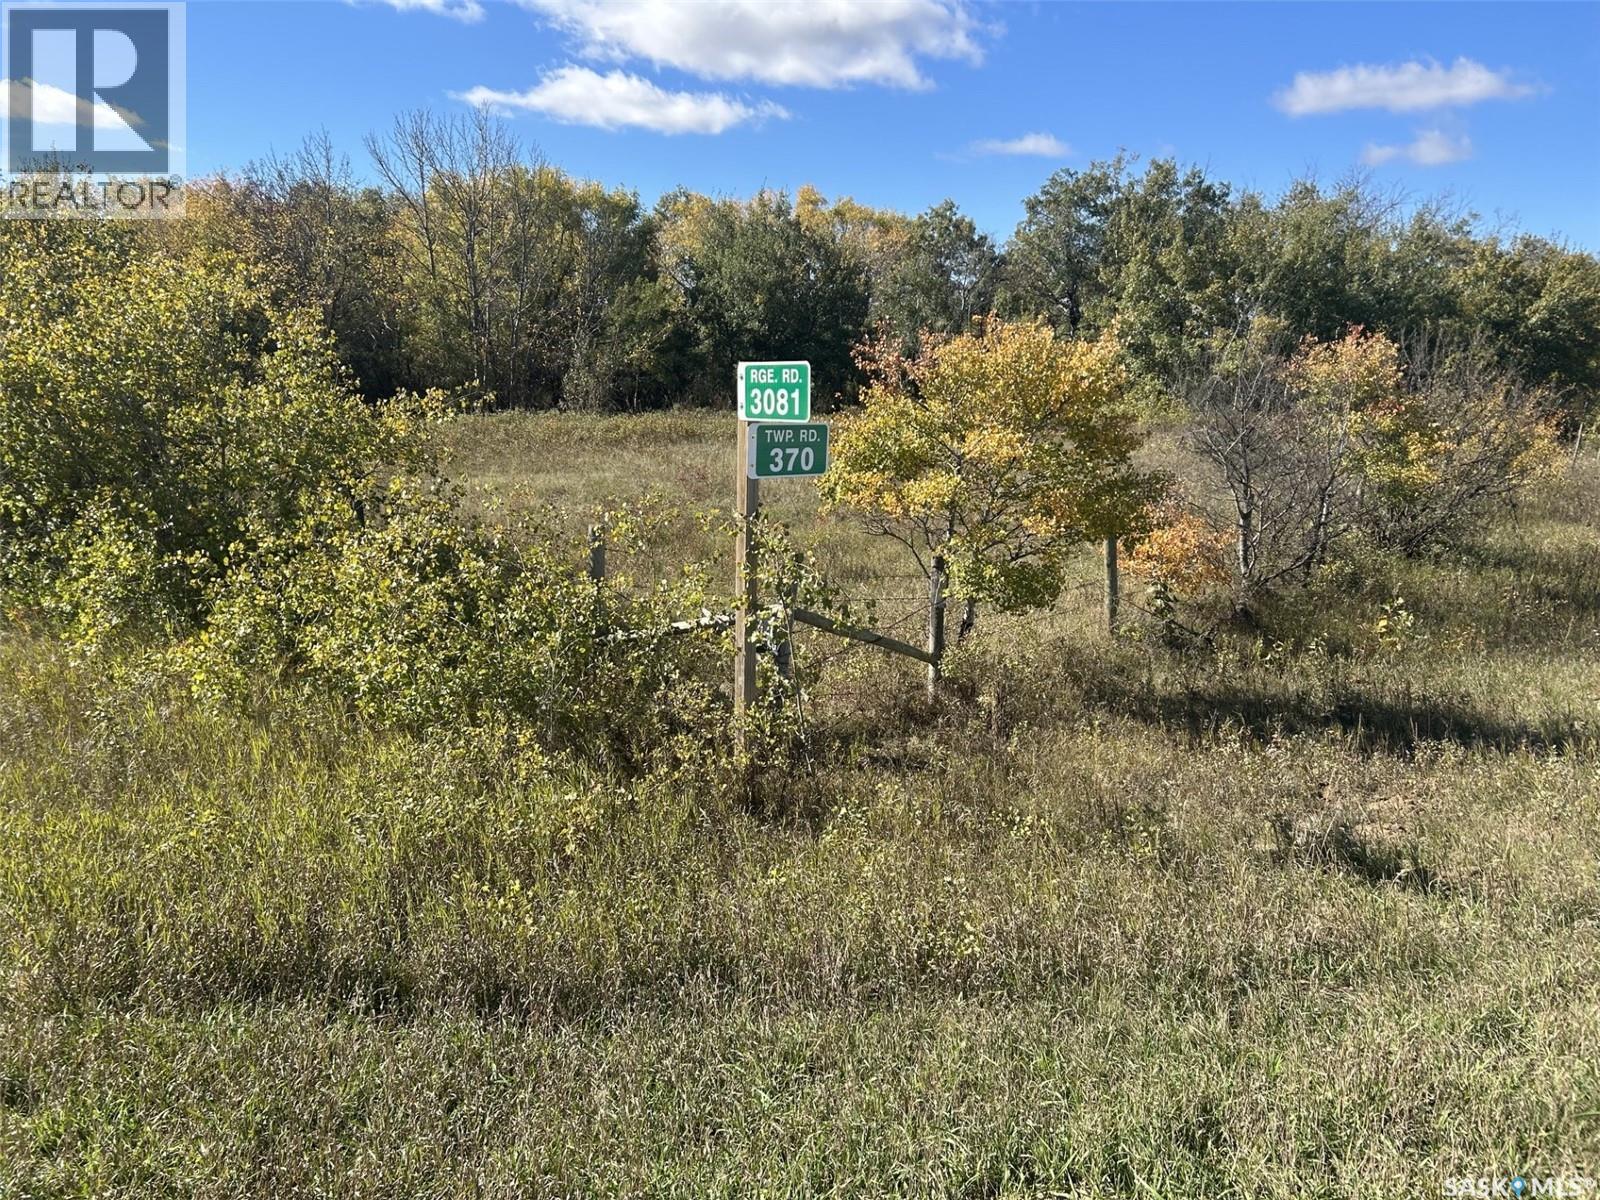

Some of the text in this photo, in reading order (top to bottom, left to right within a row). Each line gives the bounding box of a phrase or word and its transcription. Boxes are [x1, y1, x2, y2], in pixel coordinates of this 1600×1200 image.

[750, 368, 802, 383] RGE. RD.
[750, 388, 800, 415] 3081
[765, 429, 821, 442] TWP. RD.
[769, 447, 815, 472] 370
